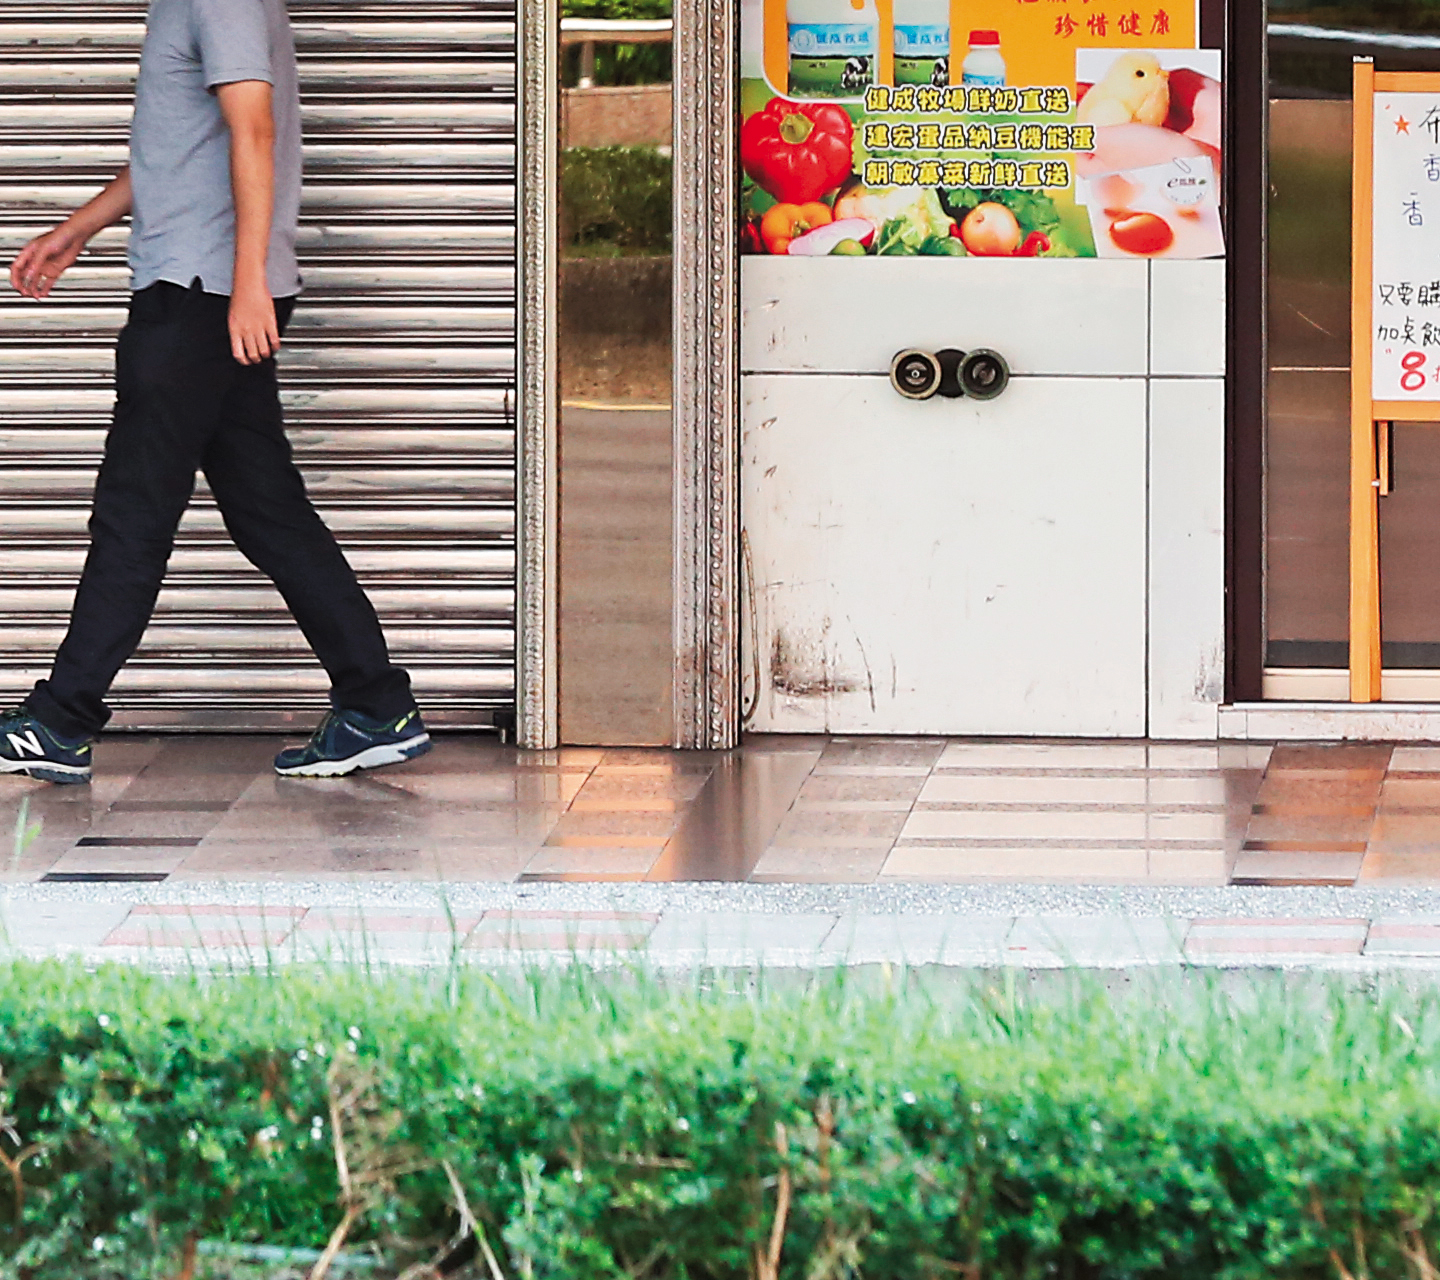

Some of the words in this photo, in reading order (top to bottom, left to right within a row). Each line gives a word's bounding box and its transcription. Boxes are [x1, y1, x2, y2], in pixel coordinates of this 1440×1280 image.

[1054, 10, 1171, 38] 珍惜健康
[865, 86, 1069, 113] 健成牧場鮮奶直送
[865, 123, 1095, 150] 建宏蛋品納豆機能蛋
[6, 730, 45, 758] N
